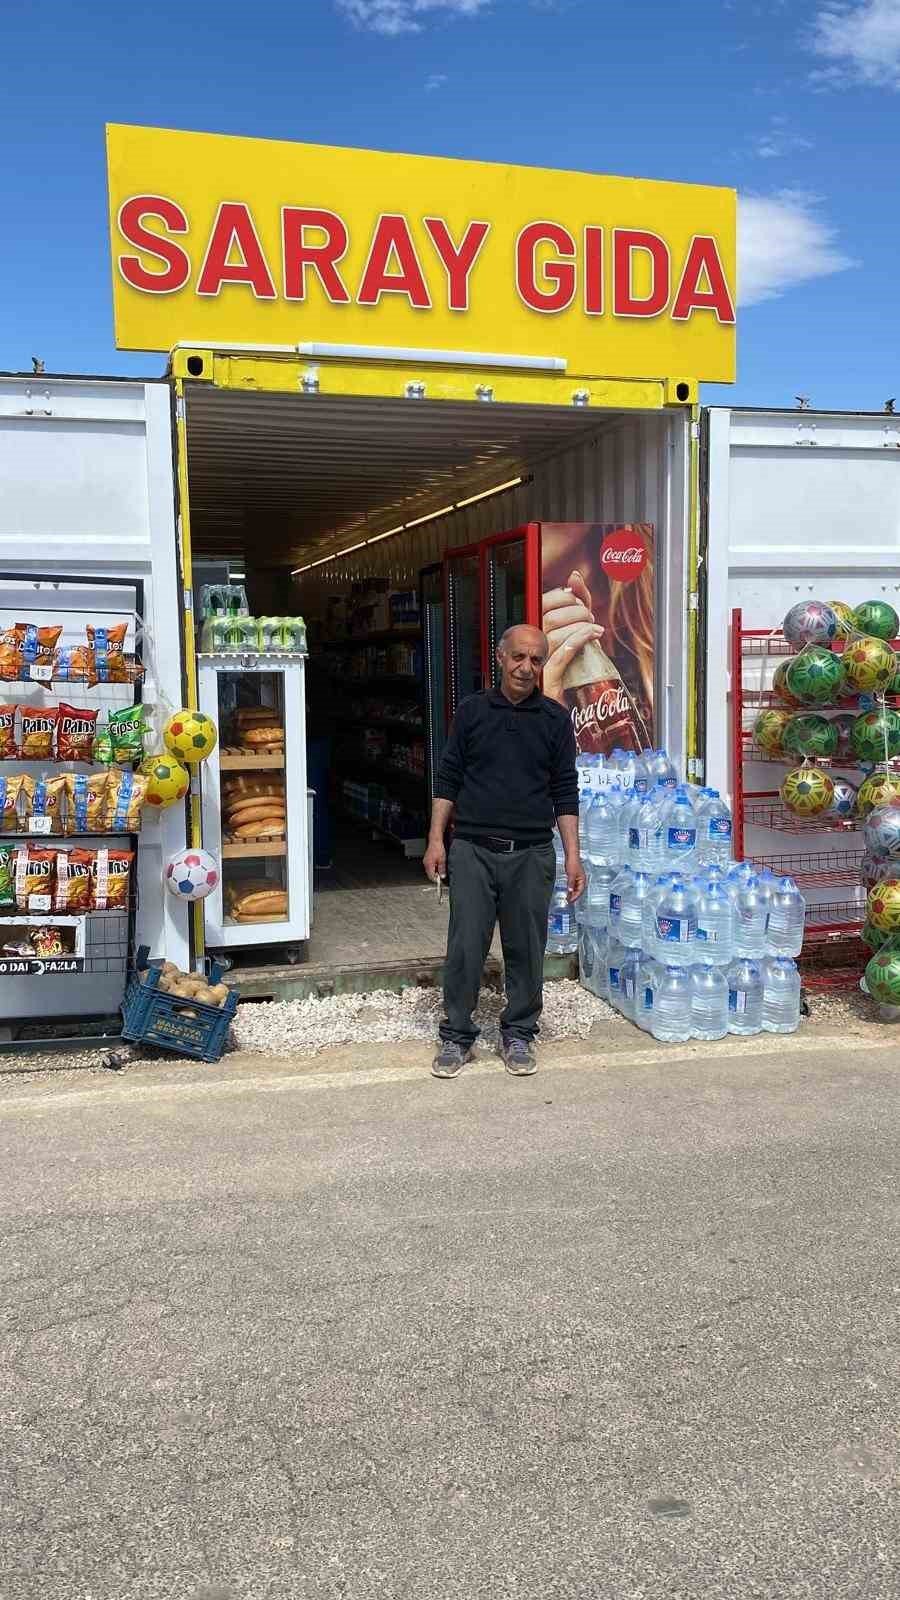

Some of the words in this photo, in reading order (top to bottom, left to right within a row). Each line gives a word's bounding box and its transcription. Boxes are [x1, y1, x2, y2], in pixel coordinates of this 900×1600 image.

[117, 194, 491, 311] SARAY
[515, 221, 736, 323] GIDA
[62, 717, 96, 735] Patos
[45, 961, 77, 971] FAZLA
